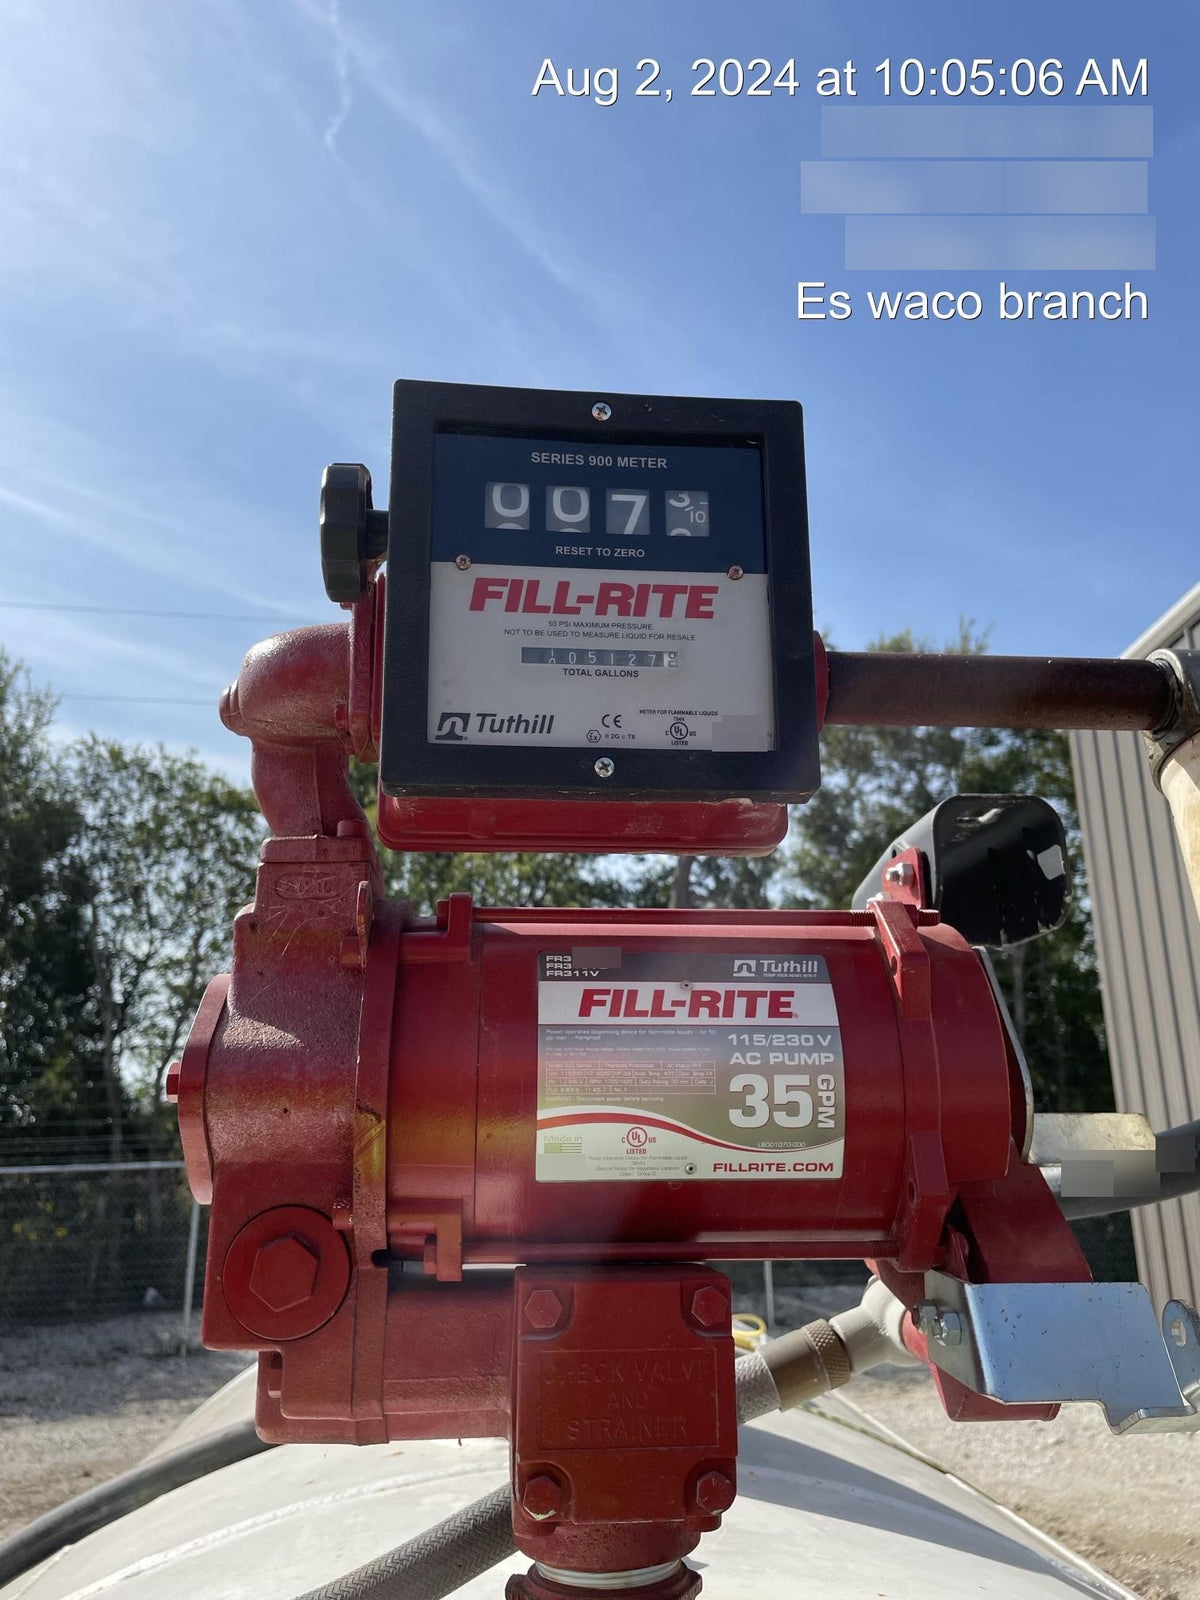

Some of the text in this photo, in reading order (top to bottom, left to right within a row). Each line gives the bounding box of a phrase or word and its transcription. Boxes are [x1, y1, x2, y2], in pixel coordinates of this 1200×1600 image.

[531, 452, 668, 469] SERIES 900 METER
[555, 545, 645, 558] RESET TO ZERO
[469, 577, 719, 619] FILL-RITE
[563, 668, 639, 678] TOTAL GALLONS
[476, 713, 554, 734] Tuthill
[760, 960, 818, 973] Tuthill
[578, 988, 795, 1019] FILL-RITE
[728, 1034, 832, 1047] 115/230 V
[730, 1052, 834, 1066] AC PUMP
[729, 1074, 813, 1128] 35
[817, 1074, 836, 1128] GPM
[631, 1131, 642, 1143] UL
[713, 1162, 834, 1172] FILLRITE.COM
[567, 1416, 689, 1441] STRAINER
